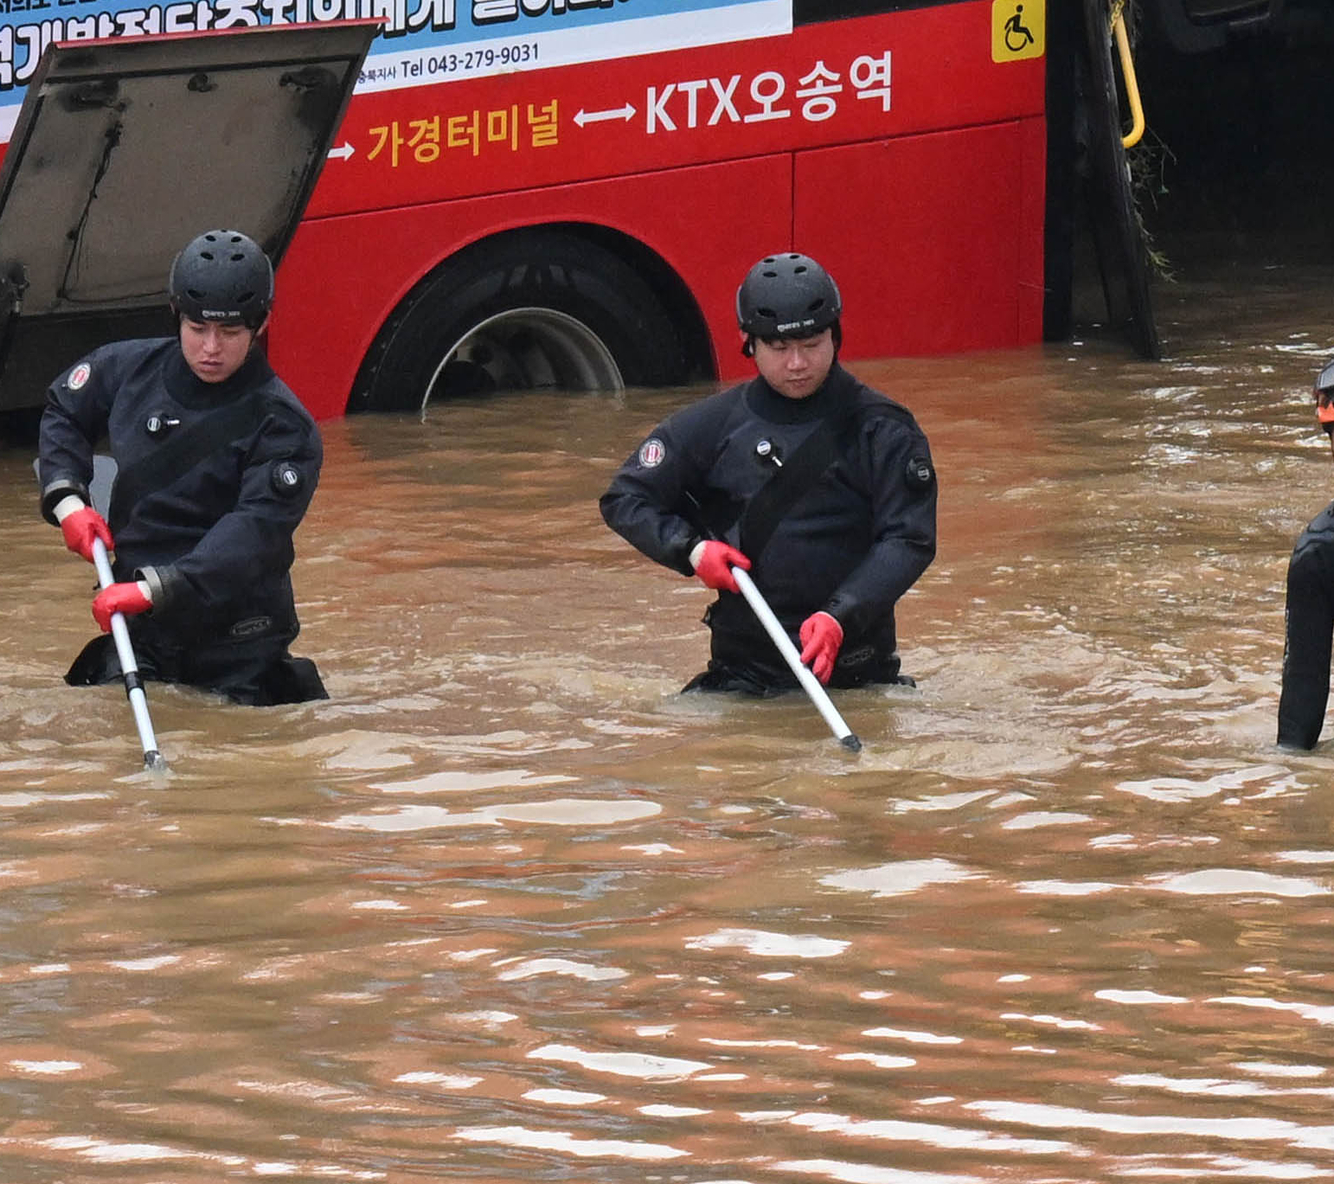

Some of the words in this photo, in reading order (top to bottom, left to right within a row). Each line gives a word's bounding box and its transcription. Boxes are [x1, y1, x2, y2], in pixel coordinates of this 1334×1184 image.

[401, 58, 423, 78] Tel
[427, 43, 538, 75] 043-279-9031
[367, 99, 559, 167] 가경터미널
[645, 50, 892, 134] KTX오송역
